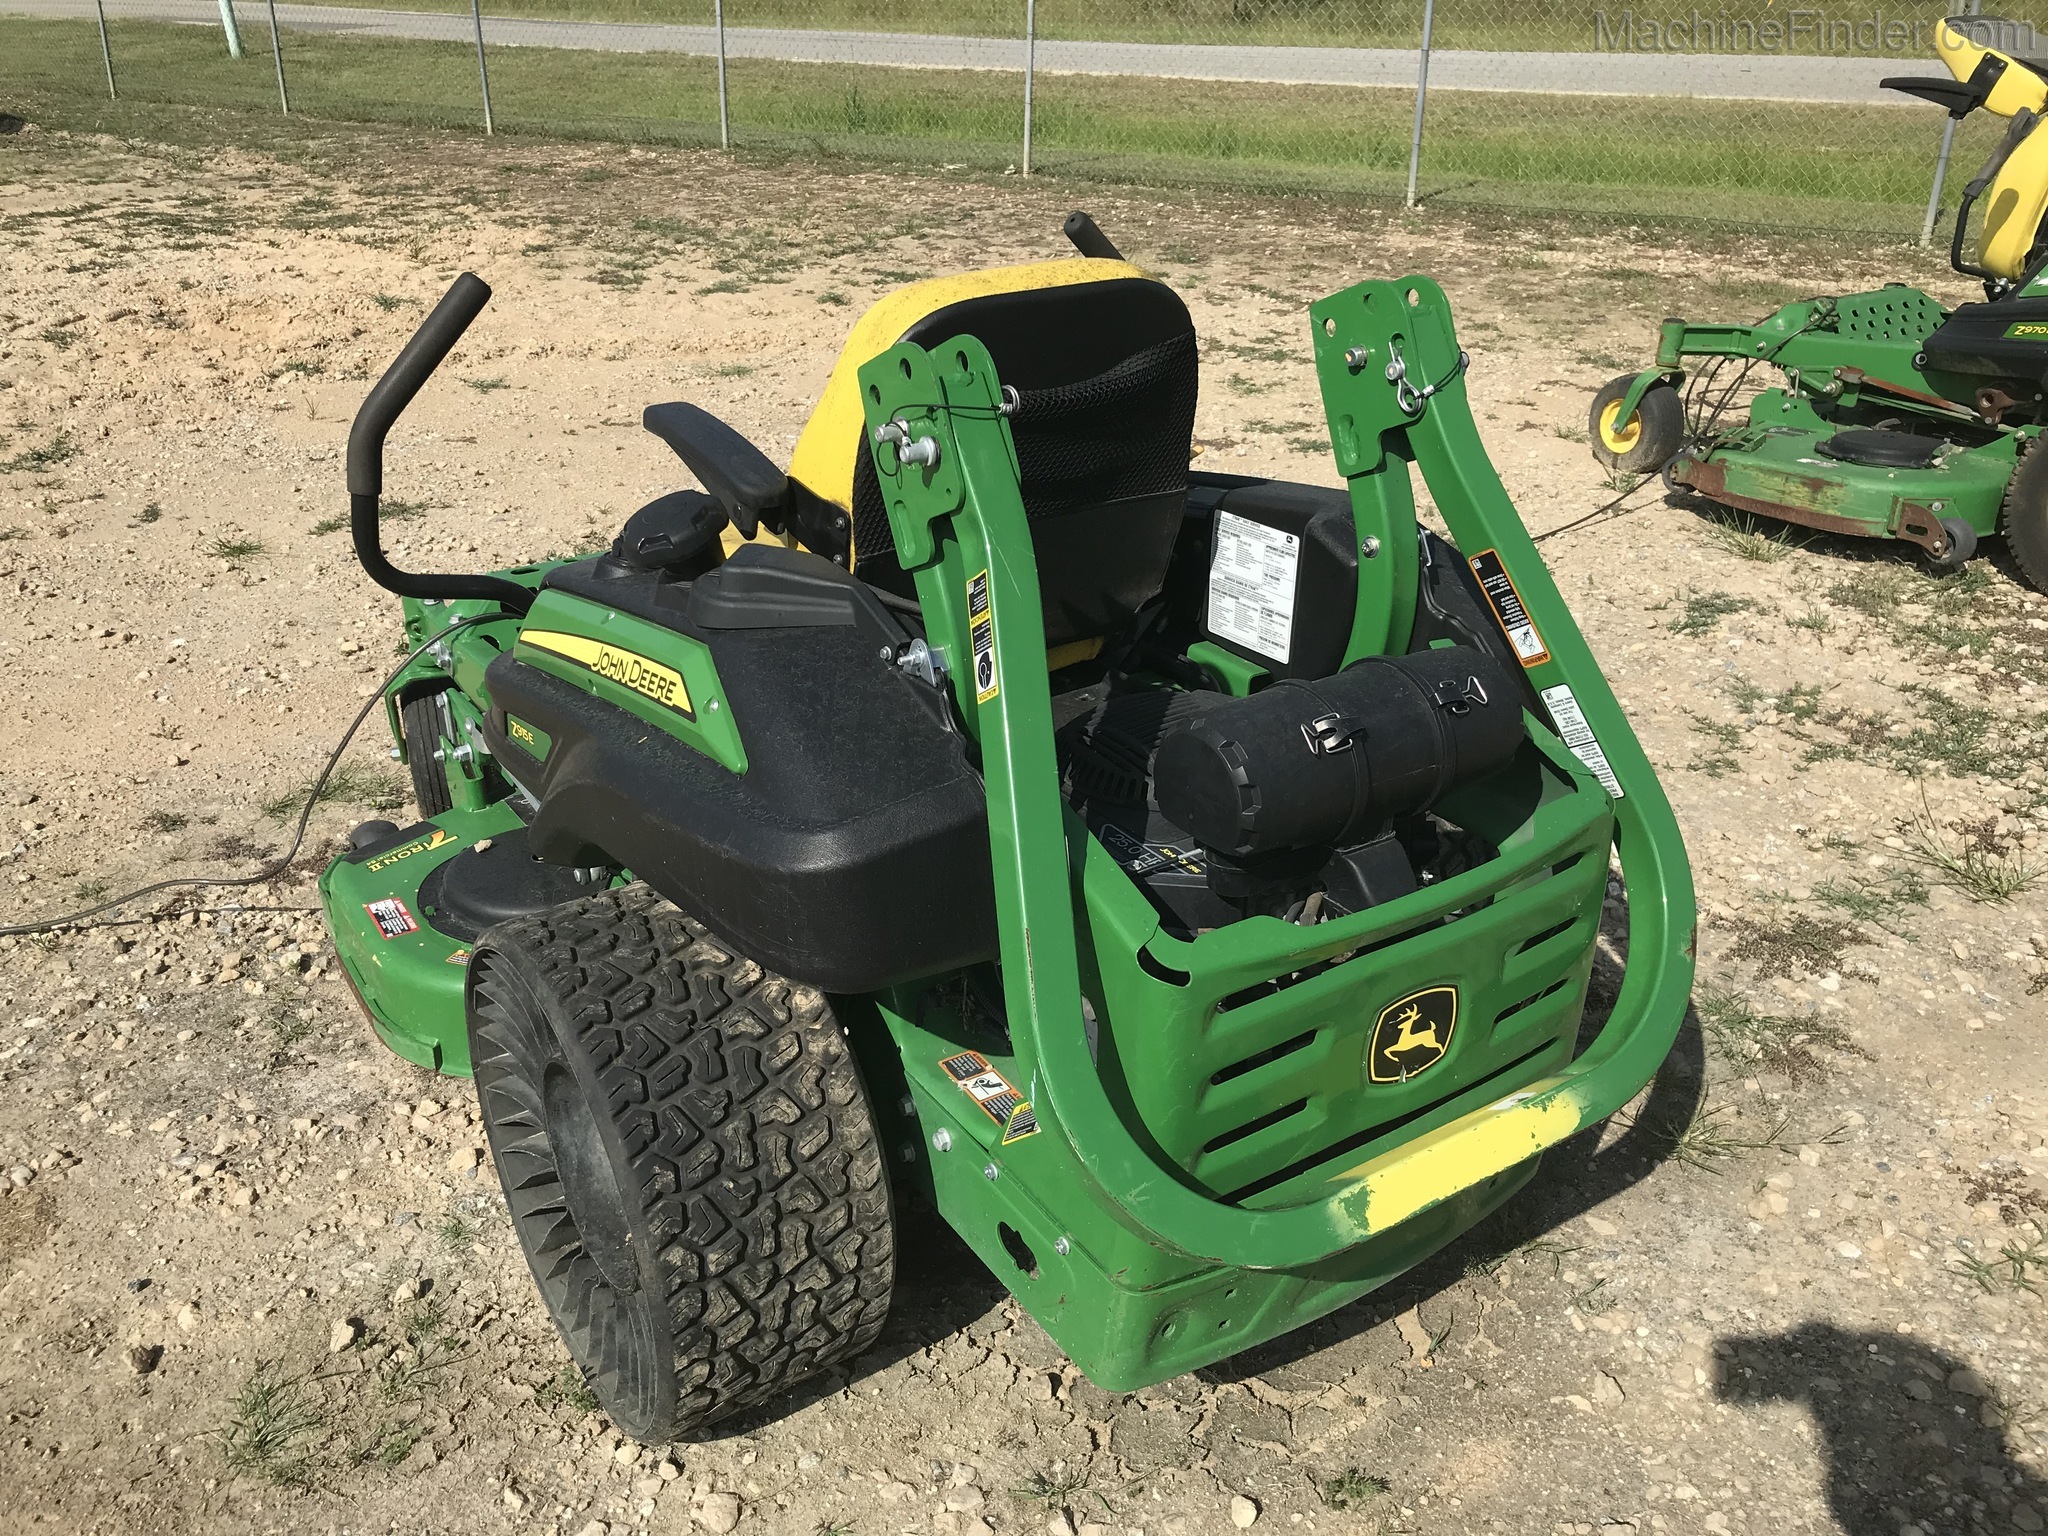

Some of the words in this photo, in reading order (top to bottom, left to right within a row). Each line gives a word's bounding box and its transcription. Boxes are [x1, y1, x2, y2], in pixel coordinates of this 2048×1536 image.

[2014, 326, 2048, 335] Z970
[592, 646, 629, 681] JOHN
[629, 659, 677, 702] DEERE
[1108, 833, 1143, 854] 25.0
